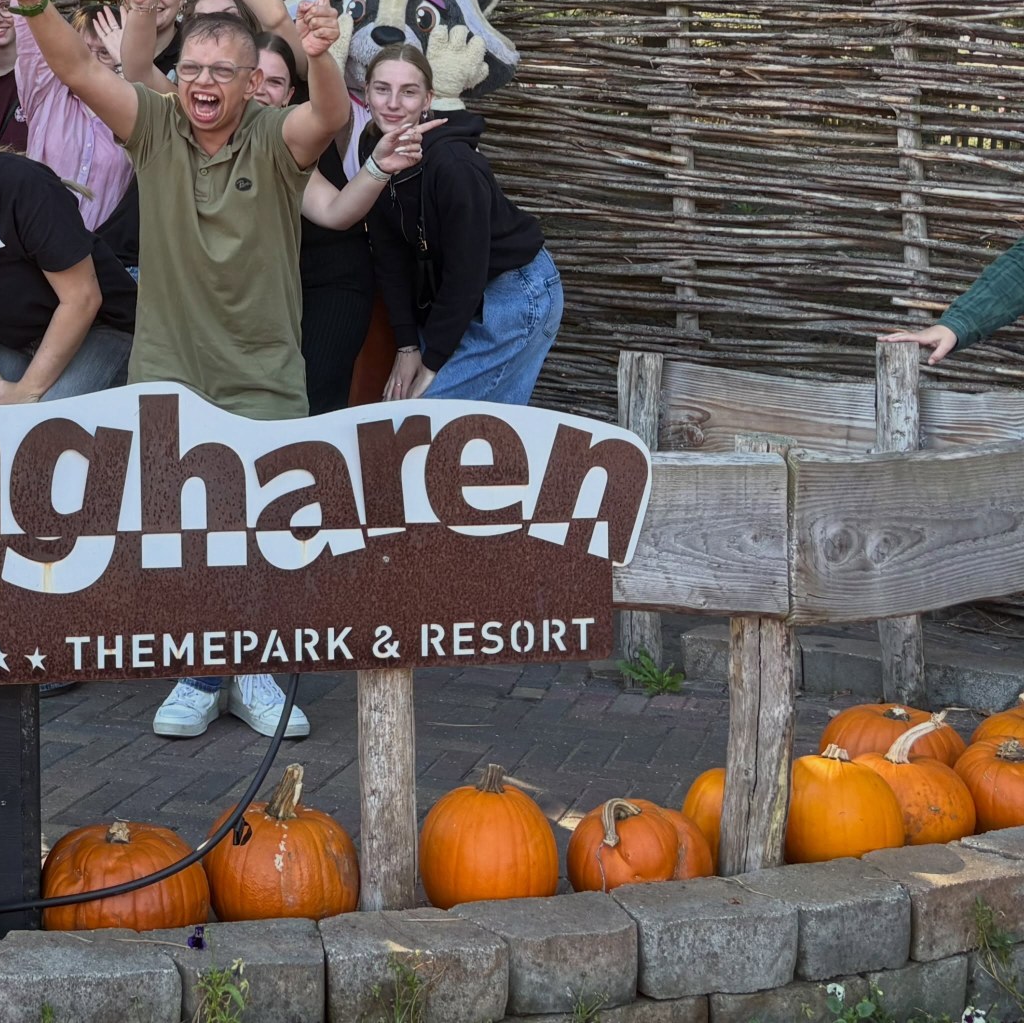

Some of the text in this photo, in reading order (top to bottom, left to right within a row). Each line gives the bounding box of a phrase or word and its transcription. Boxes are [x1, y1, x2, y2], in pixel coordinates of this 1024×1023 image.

[65, 617, 595, 670] THEMEPARK & RESORT
